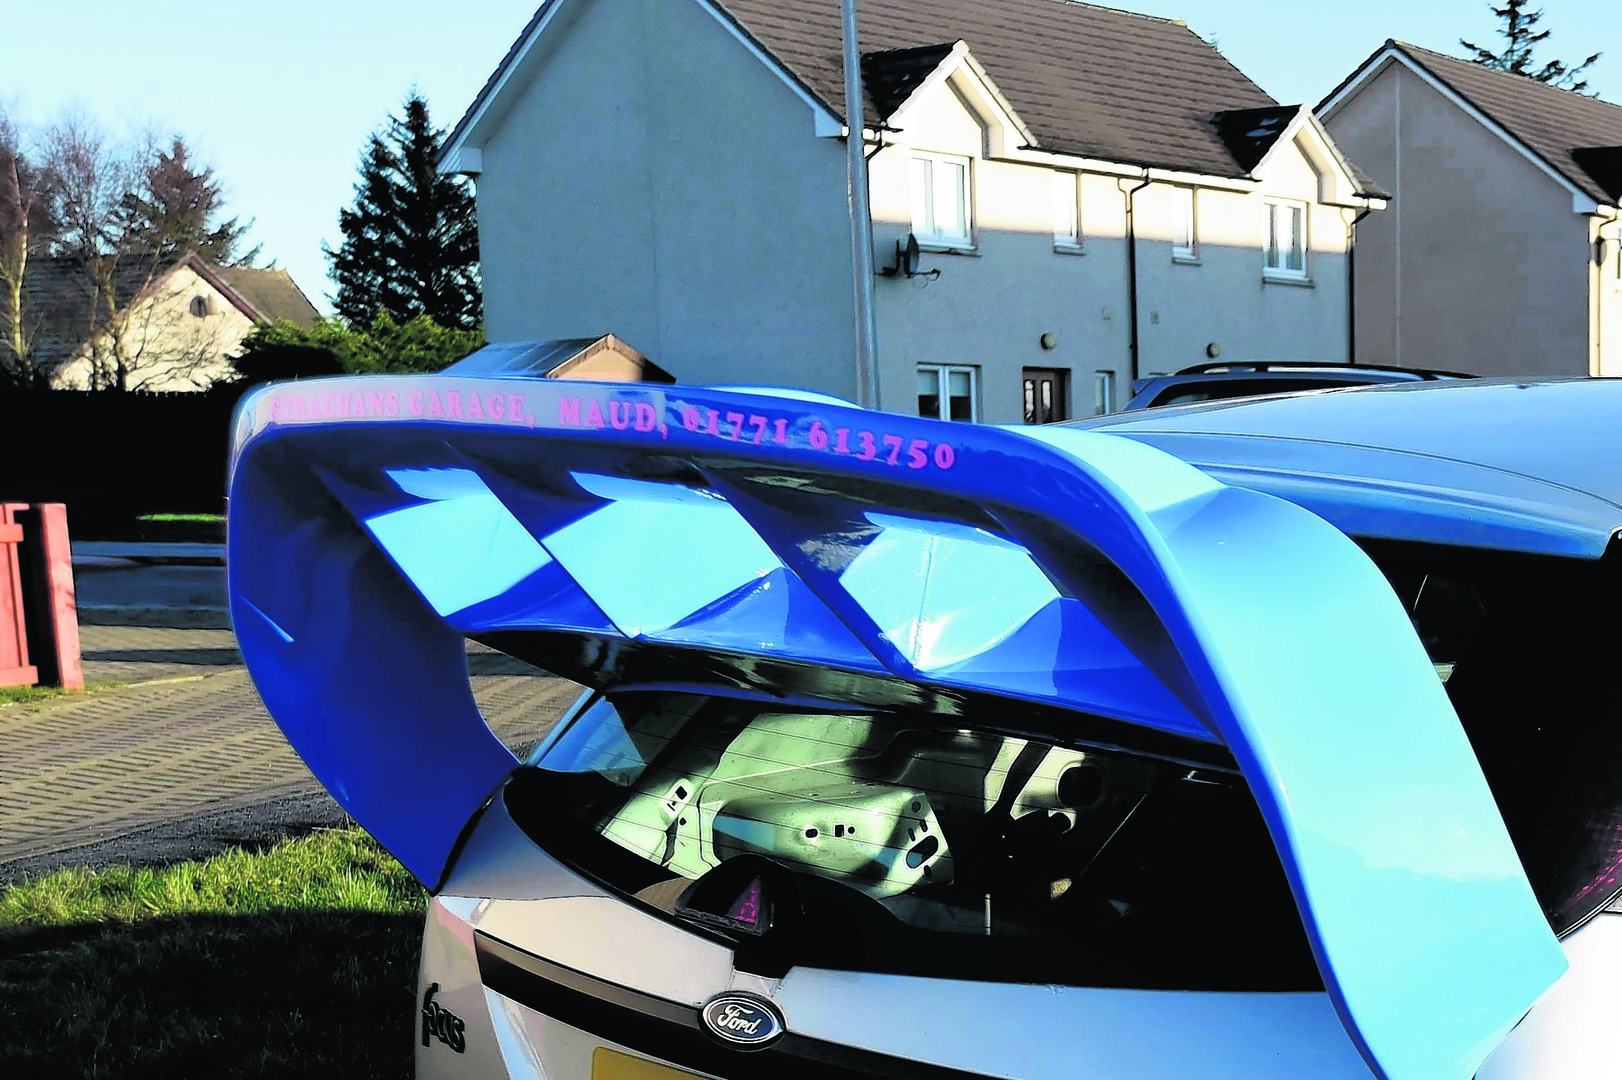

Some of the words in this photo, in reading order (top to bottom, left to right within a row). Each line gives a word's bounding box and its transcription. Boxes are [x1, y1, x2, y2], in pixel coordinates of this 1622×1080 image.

[407, 390, 537, 430] GARAGE,
[558, 396, 668, 439] MAUD,
[682, 406, 790, 446] 01771
[807, 420, 957, 469] 613750
[717, 1004, 762, 1035] Ford
